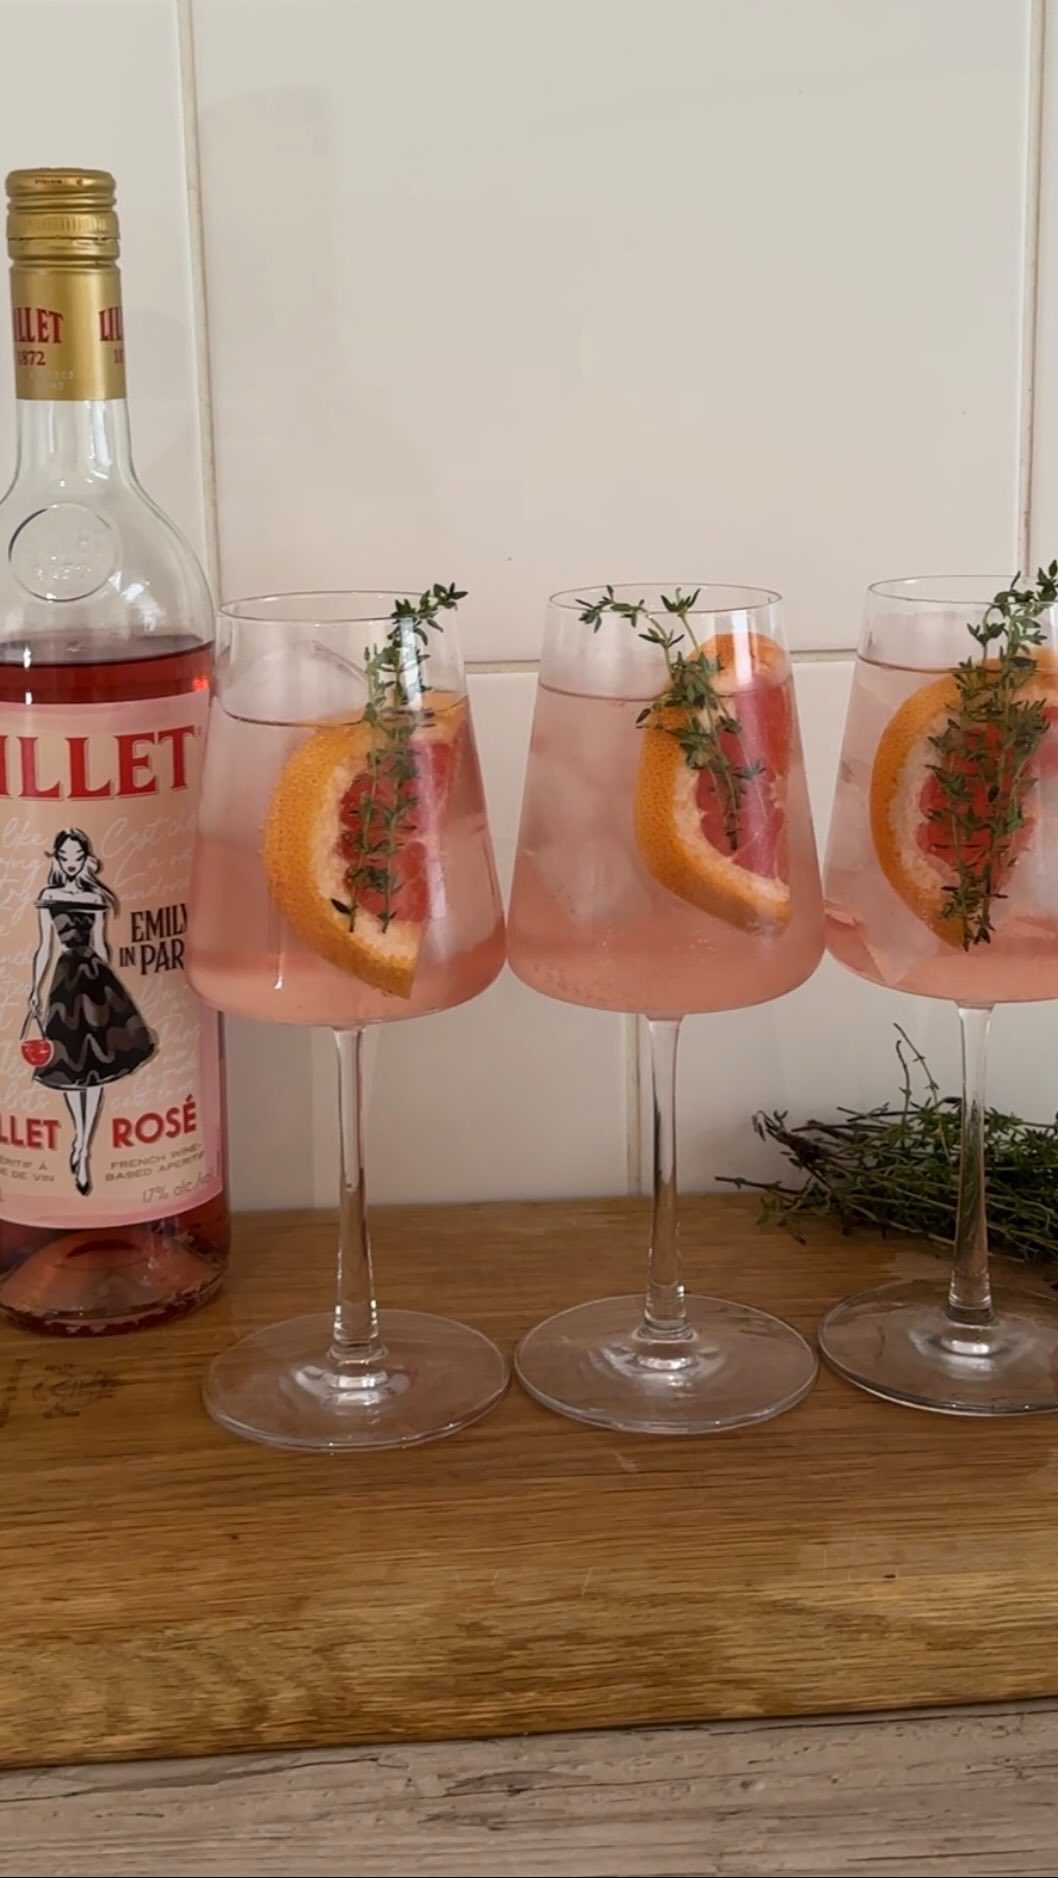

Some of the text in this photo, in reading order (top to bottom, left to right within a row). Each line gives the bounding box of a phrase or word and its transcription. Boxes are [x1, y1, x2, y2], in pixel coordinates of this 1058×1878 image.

[119, 946, 136, 968] IN
[112, 1094, 197, 1149] ROSÉ
[110, 1154, 166, 1169] FRENCH
[105, 1168, 153, 1182] BASED
[143, 1184, 168, 1204] 17%
